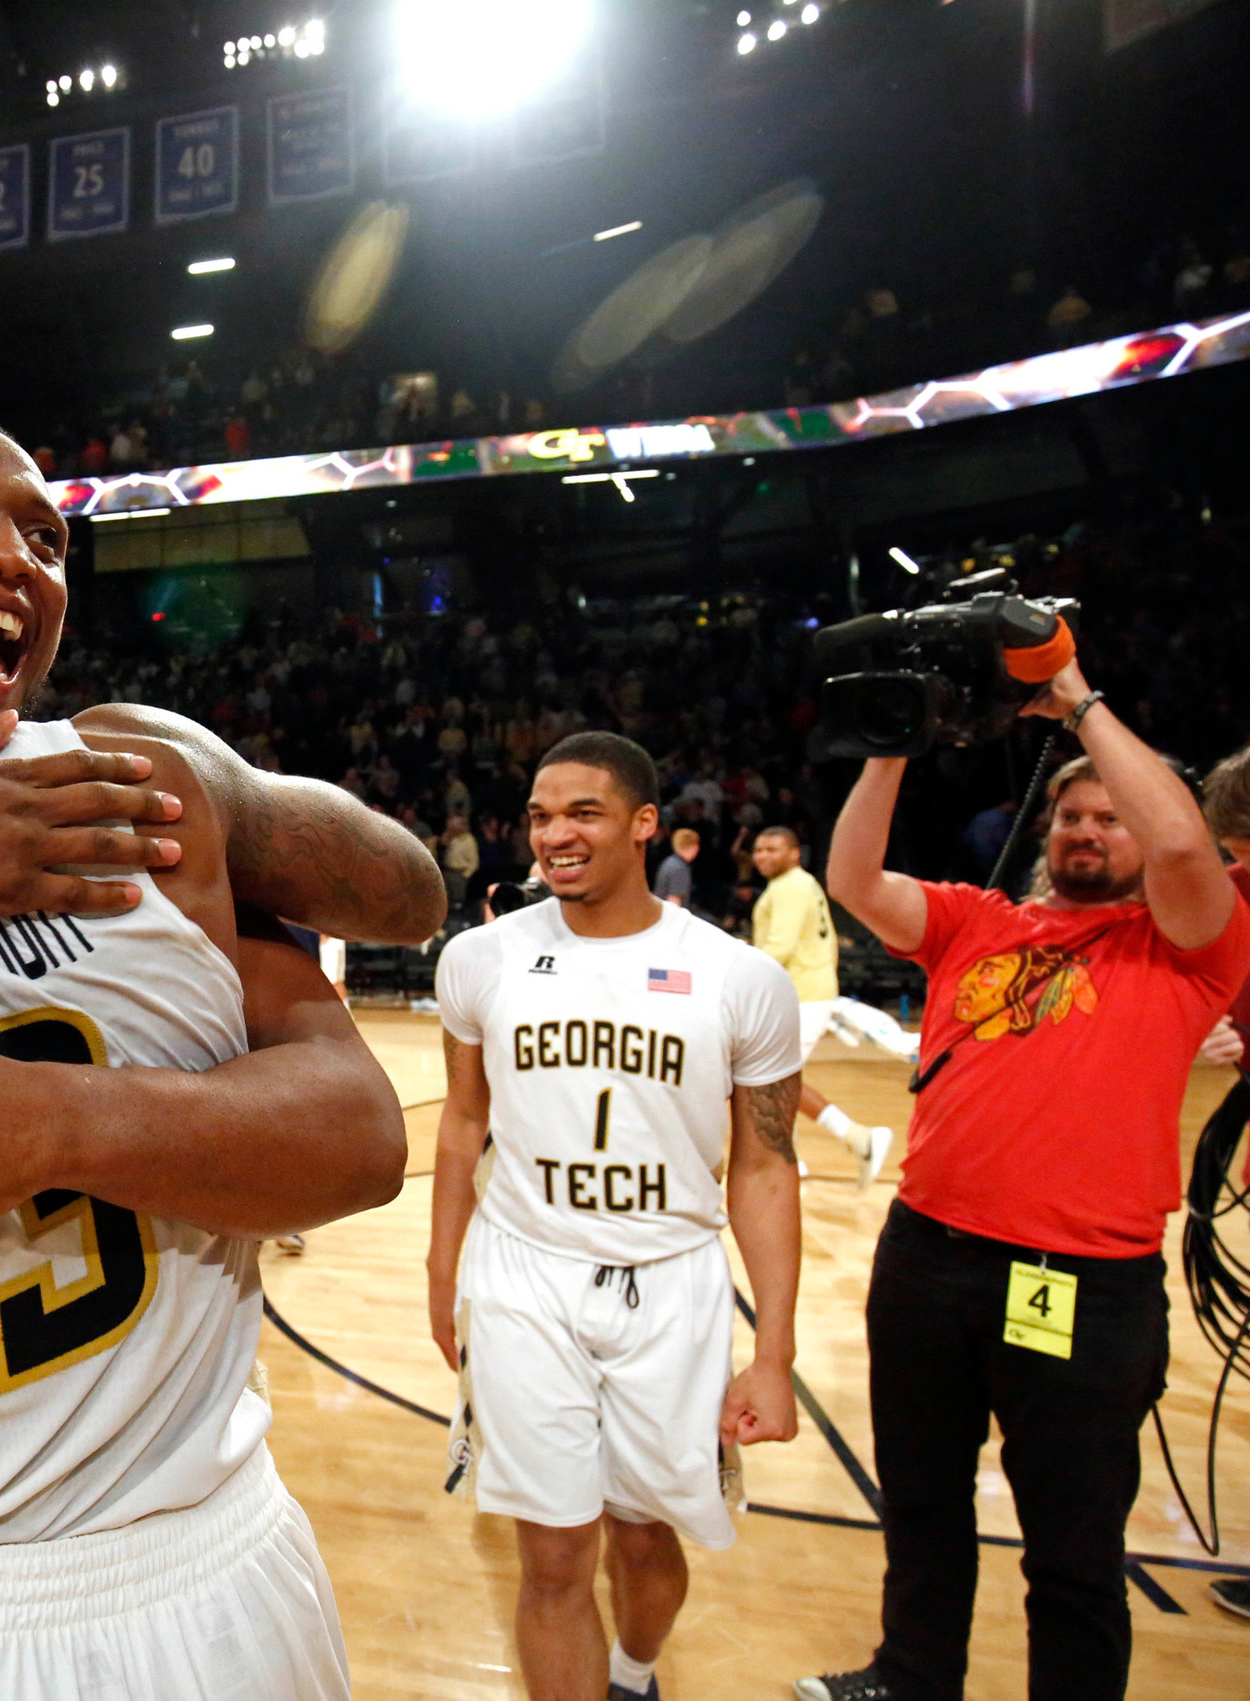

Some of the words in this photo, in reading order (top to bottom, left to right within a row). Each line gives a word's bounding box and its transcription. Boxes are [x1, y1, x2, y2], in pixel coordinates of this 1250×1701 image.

[74, 164, 104, 199] 25
[177, 144, 215, 180] 40
[514, 1019, 685, 1087] GEORGIA
[593, 1086, 613, 1152] 1
[535, 1157, 667, 1213] TECH
[1028, 1284, 1052, 1318] 4
